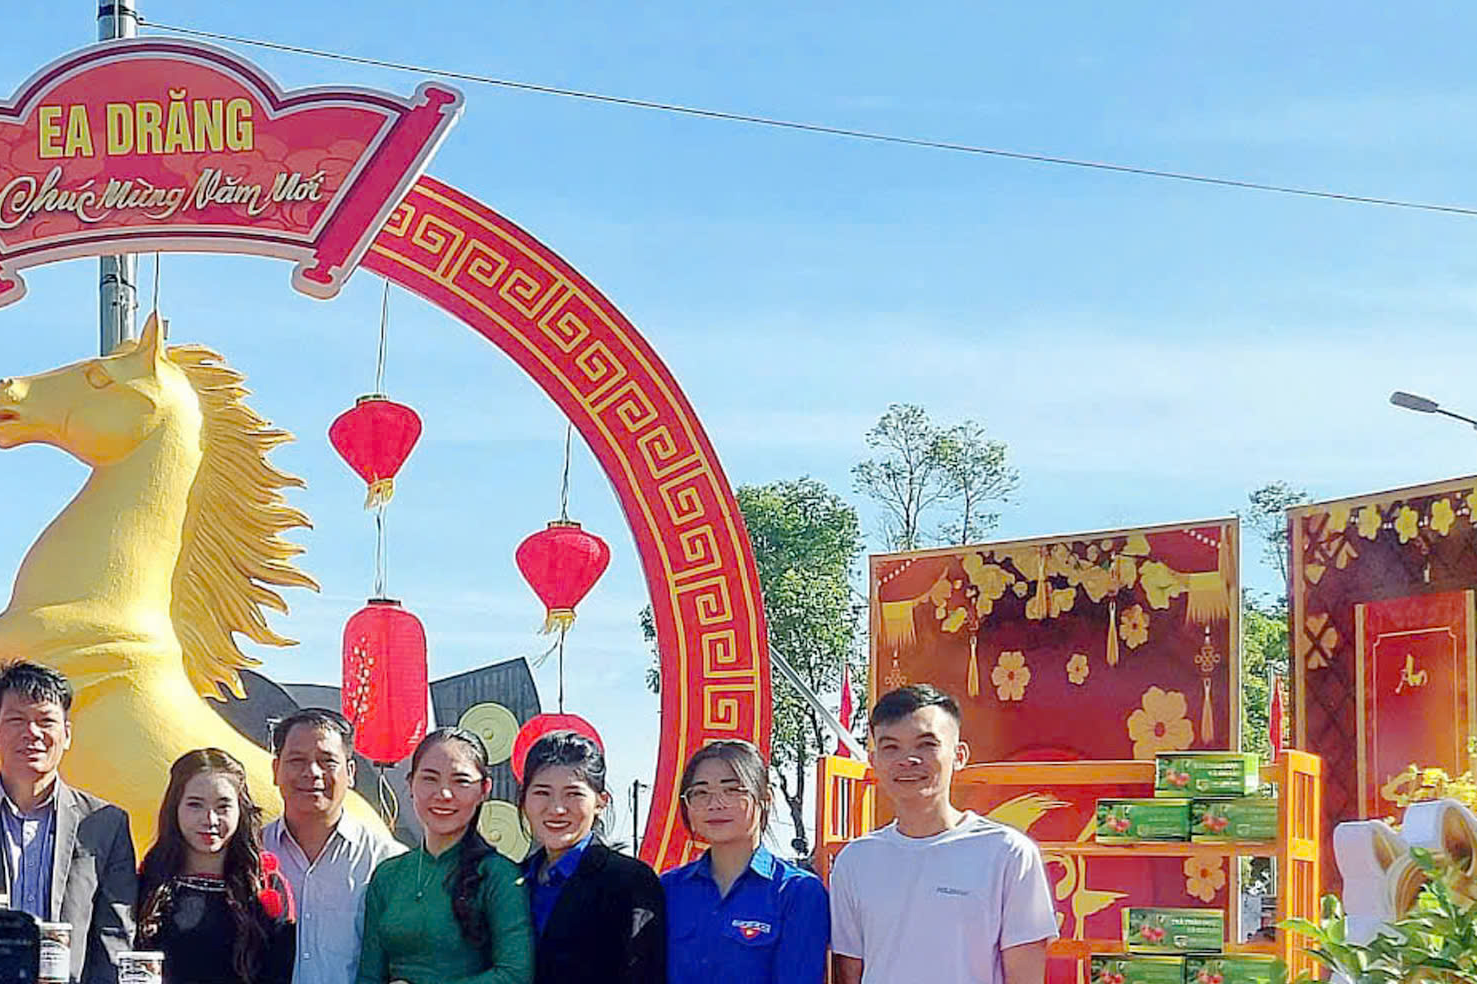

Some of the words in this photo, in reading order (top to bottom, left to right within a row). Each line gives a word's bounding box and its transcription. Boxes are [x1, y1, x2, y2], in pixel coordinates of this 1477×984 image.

[37, 103, 95, 159] EA
[105, 88, 255, 157] DRĂNG
[96, 177, 186, 220] Mừng
[182, 168, 271, 216] Năm
